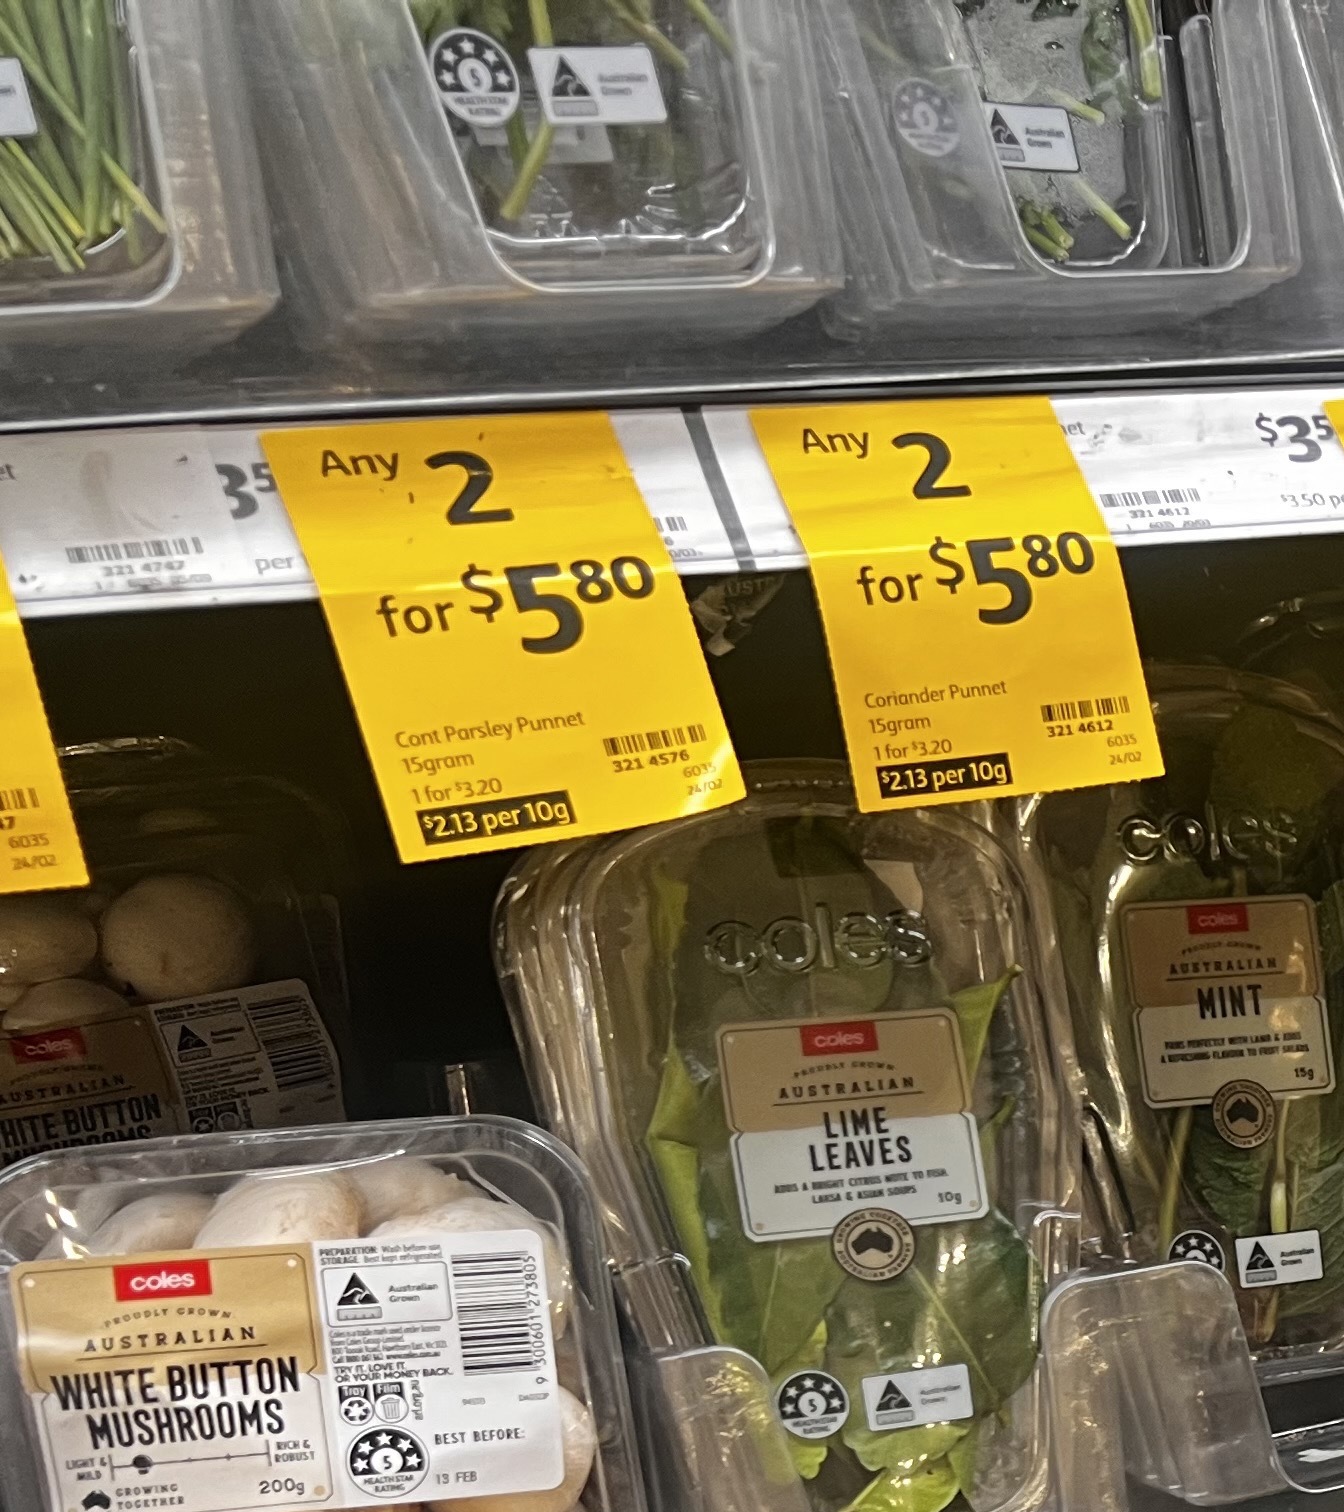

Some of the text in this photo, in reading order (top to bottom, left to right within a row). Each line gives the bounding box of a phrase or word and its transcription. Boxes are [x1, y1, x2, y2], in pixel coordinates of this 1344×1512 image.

[801, 428, 972, 500] Any 2
[320, 450, 514, 525] Any 2
[857, 566, 922, 606] for
[377, 595, 454, 638] for
[864, 680, 1007, 710] Coriander Punnet
[396, 711, 585, 749] Cont Parsley Punnet
[868, 714, 931, 736] 15gram
[1047, 719, 1114, 737] 321 4612
[401, 749, 475, 777] 15gram
[881, 761, 1008, 792] $2.13 per 10g
[424, 800, 571, 838] $2.13 per 10g
[1196, 984, 1262, 1020] MINT
[814, 1030, 864, 1048] coles
[778, 1075, 914, 1099] AUSTRALIAN
[823, 1106, 888, 1140] LIME
[808, 1136, 913, 1172] LEAVES
[130, 1270, 194, 1291] coles
[84, 1324, 256, 1352] AUSTRALIAN
[50, 1356, 300, 1411] WHITE BUTTON
[86, 1398, 285, 1450] MUSHROOMS
[434, 1430, 466, 1445] BEST
[258, 1478, 305, 1496] 200g
[436, 1470, 478, 1485] 13 FEB
